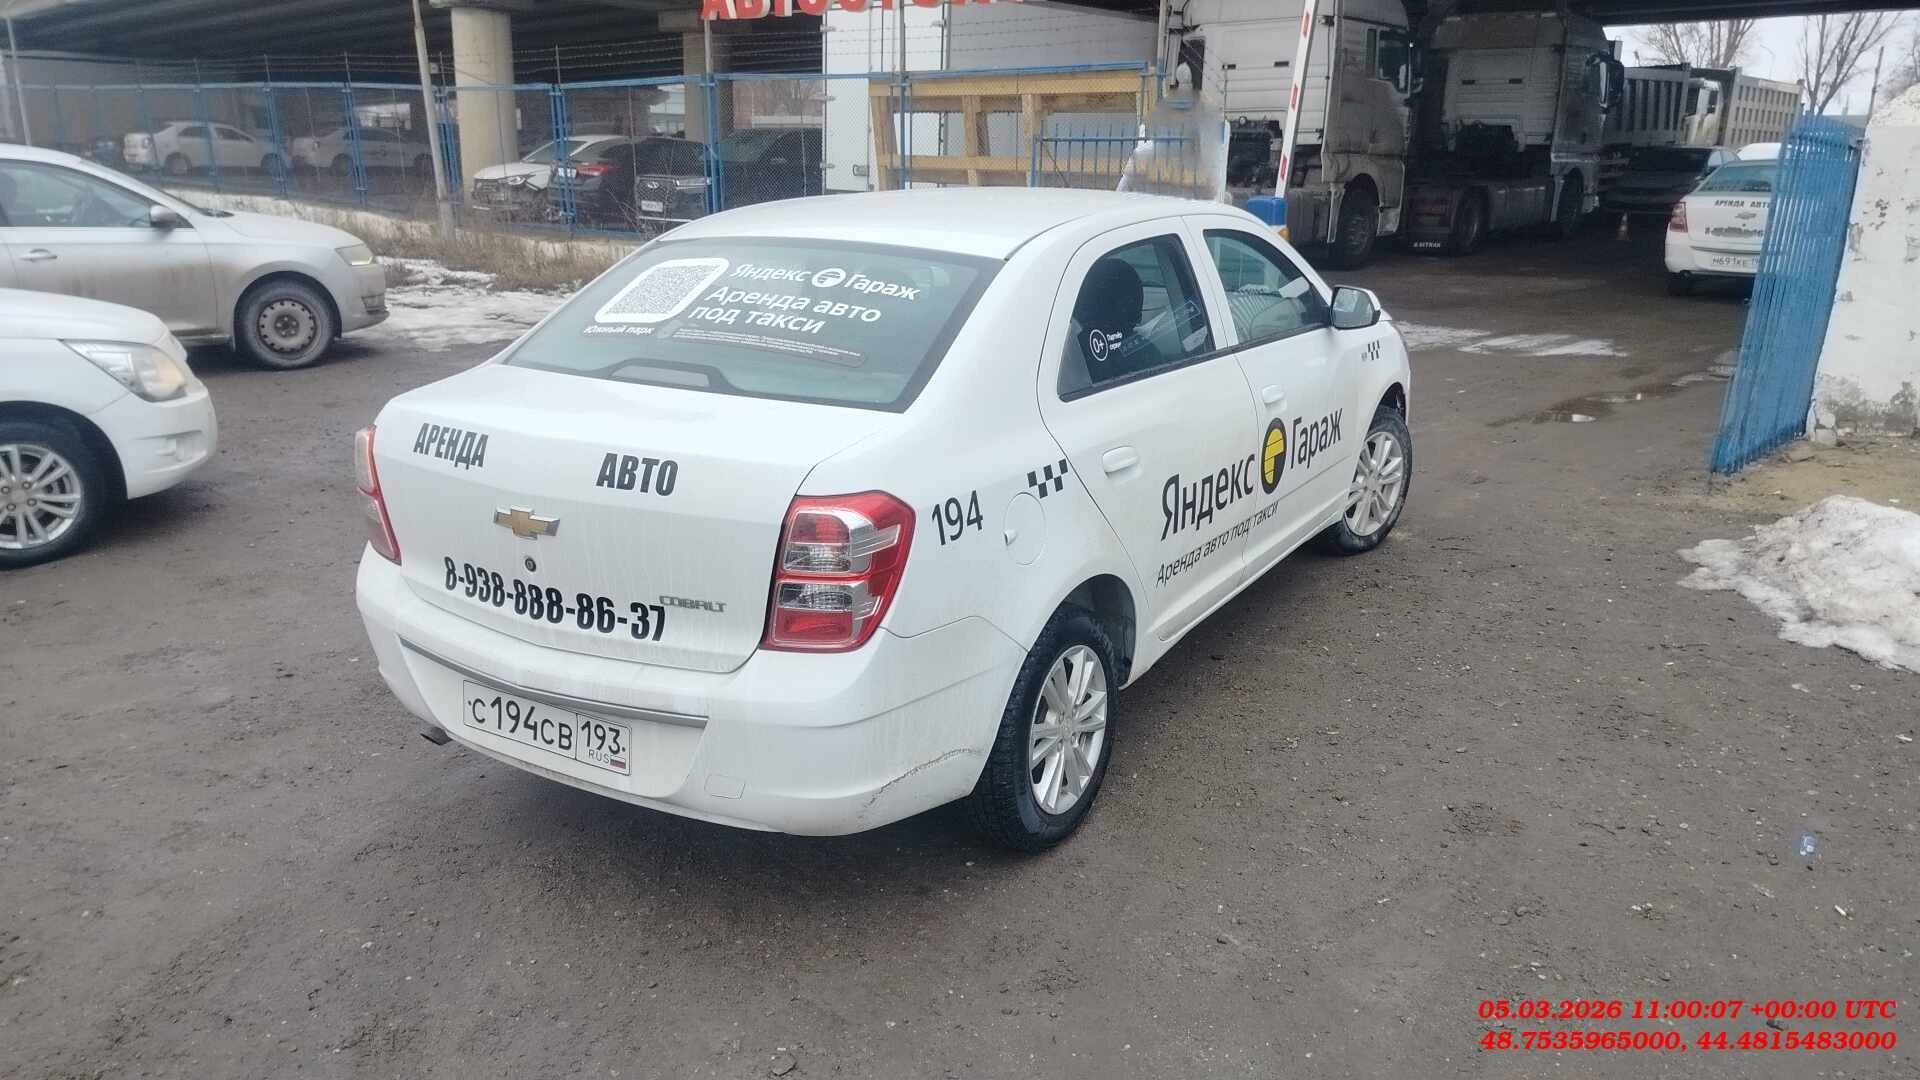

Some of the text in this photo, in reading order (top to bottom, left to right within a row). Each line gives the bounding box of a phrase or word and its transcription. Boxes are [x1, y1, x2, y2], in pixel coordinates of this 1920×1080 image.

[704, 285, 882, 324] Аренда авто
[730, 263, 920, 301] Яндекс Гараж
[688, 305, 825, 335] под такси
[412, 422, 679, 498] АРЕНДА АВТО
[1160, 407, 1343, 542] Яндекс Гараж
[931, 489, 984, 547] 194
[1156, 501, 1279, 588] Аренда авто под такси
[443, 556, 667, 643] 8-938-888-86-37
[659, 595, 728, 613] COBALT
[472, 696, 622, 756] С194СВ 193
[588, 749, 611, 765] RUS
